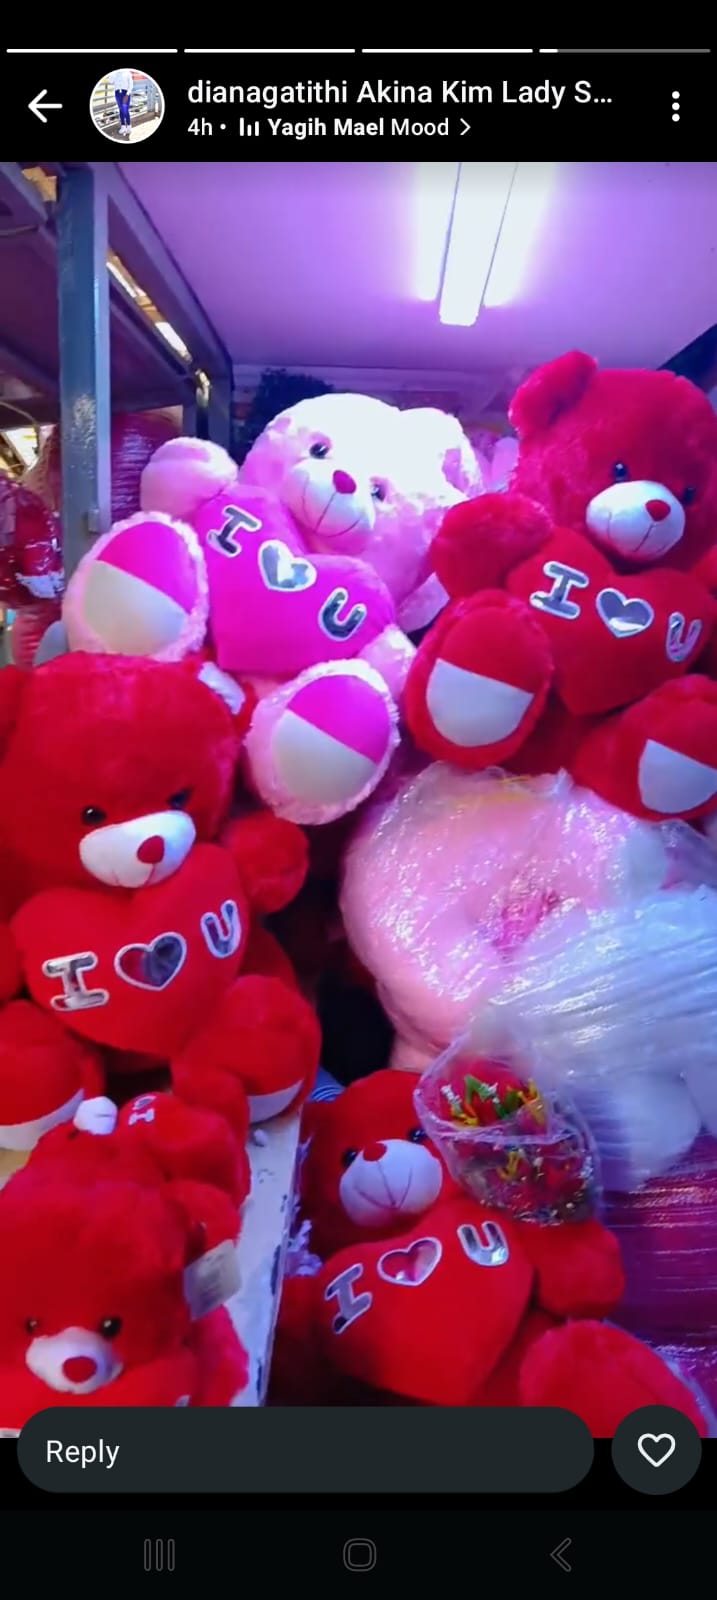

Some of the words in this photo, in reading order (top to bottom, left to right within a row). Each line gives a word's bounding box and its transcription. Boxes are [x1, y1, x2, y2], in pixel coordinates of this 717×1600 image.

[207, 504, 262, 557] I
[318, 588, 368, 641] U
[529, 560, 590, 619] I
[665, 612, 702, 662] U
[42, 951, 109, 1011] I
[200, 899, 242, 958] U
[324, 1263, 372, 1334] I
[456, 1221, 510, 1267] U
